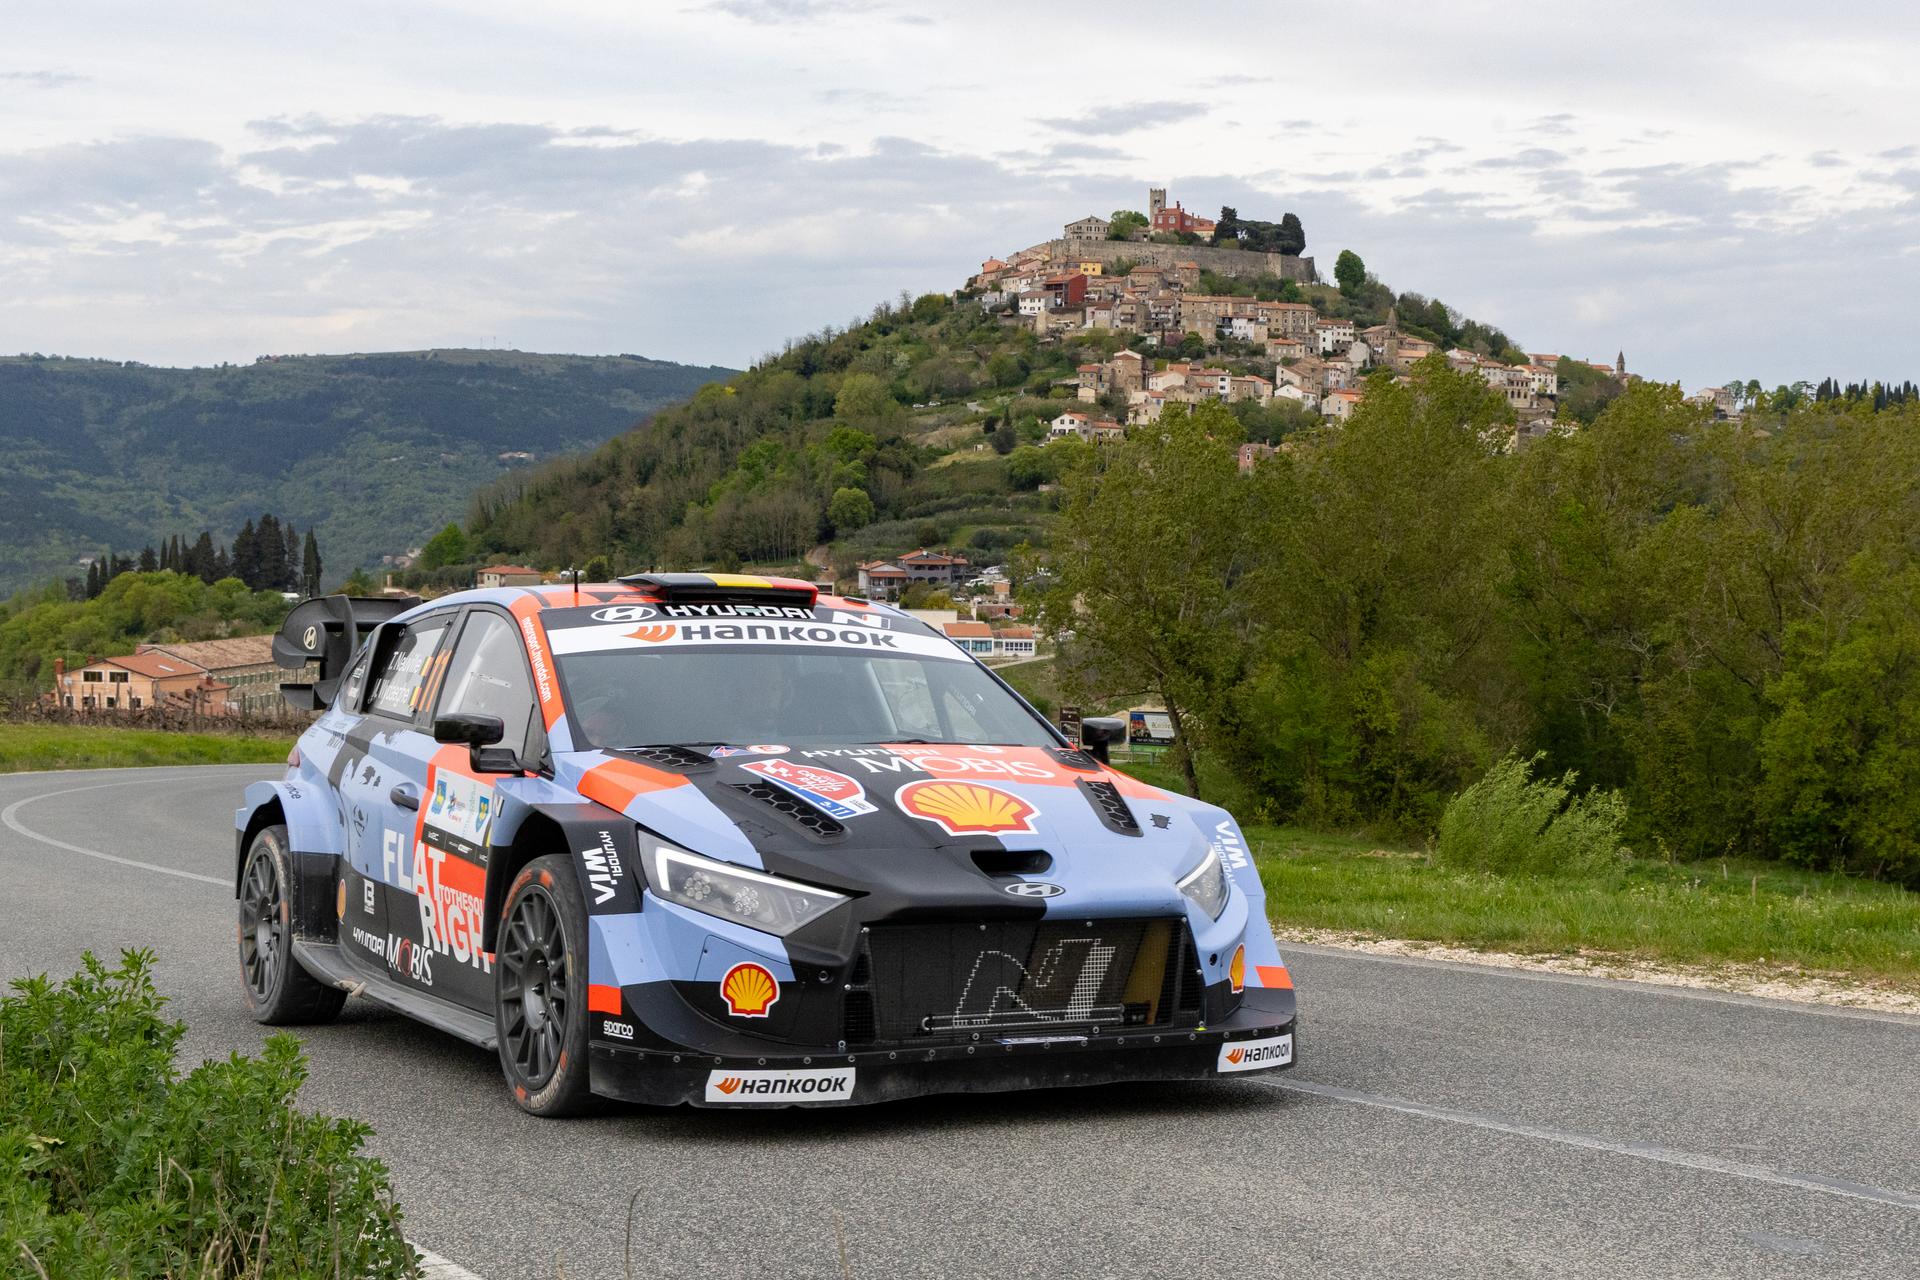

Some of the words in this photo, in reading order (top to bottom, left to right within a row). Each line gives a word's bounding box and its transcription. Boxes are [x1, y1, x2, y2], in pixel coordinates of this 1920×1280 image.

[665, 605, 817, 620] HYUNDAI
[800, 748, 942, 758] HYUNDAI
[850, 756, 1056, 779] MOBIS
[598, 831, 624, 876] HYUNDAI
[383, 828, 446, 903] FLAT
[352, 926, 386, 957] HYUNDAI
[386, 933, 434, 986] MOBIS
[603, 1020, 634, 1037] sparco
